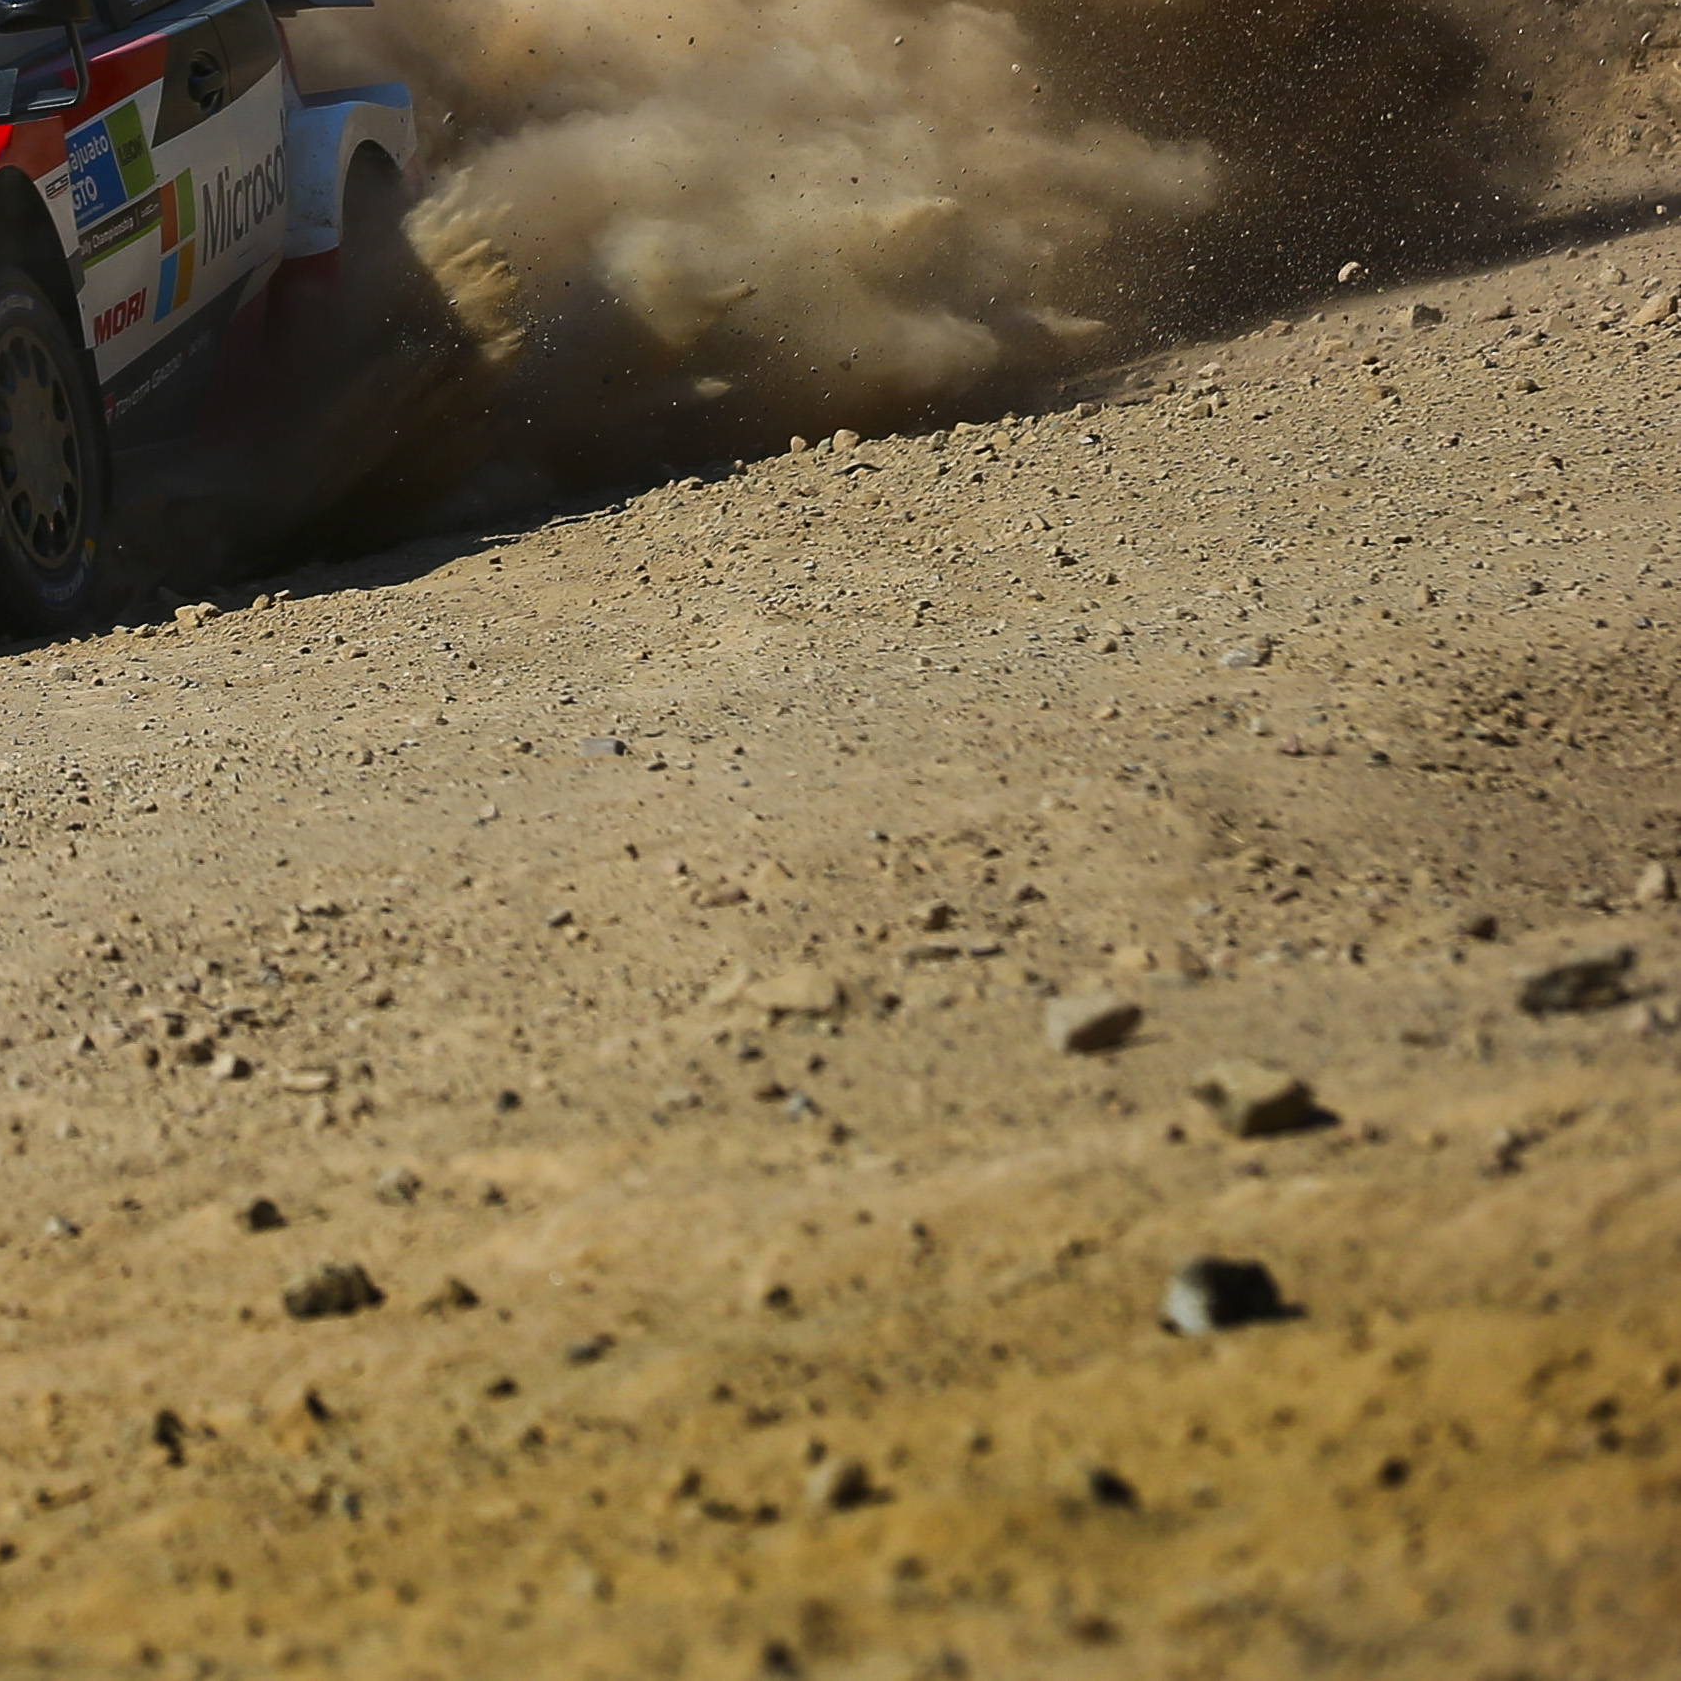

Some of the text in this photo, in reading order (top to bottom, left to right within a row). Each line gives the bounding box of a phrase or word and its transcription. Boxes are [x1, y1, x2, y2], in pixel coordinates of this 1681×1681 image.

[69, 135, 109, 173] ajuato
[202, 108, 286, 267] Microso
[94, 287, 148, 348] MORI
